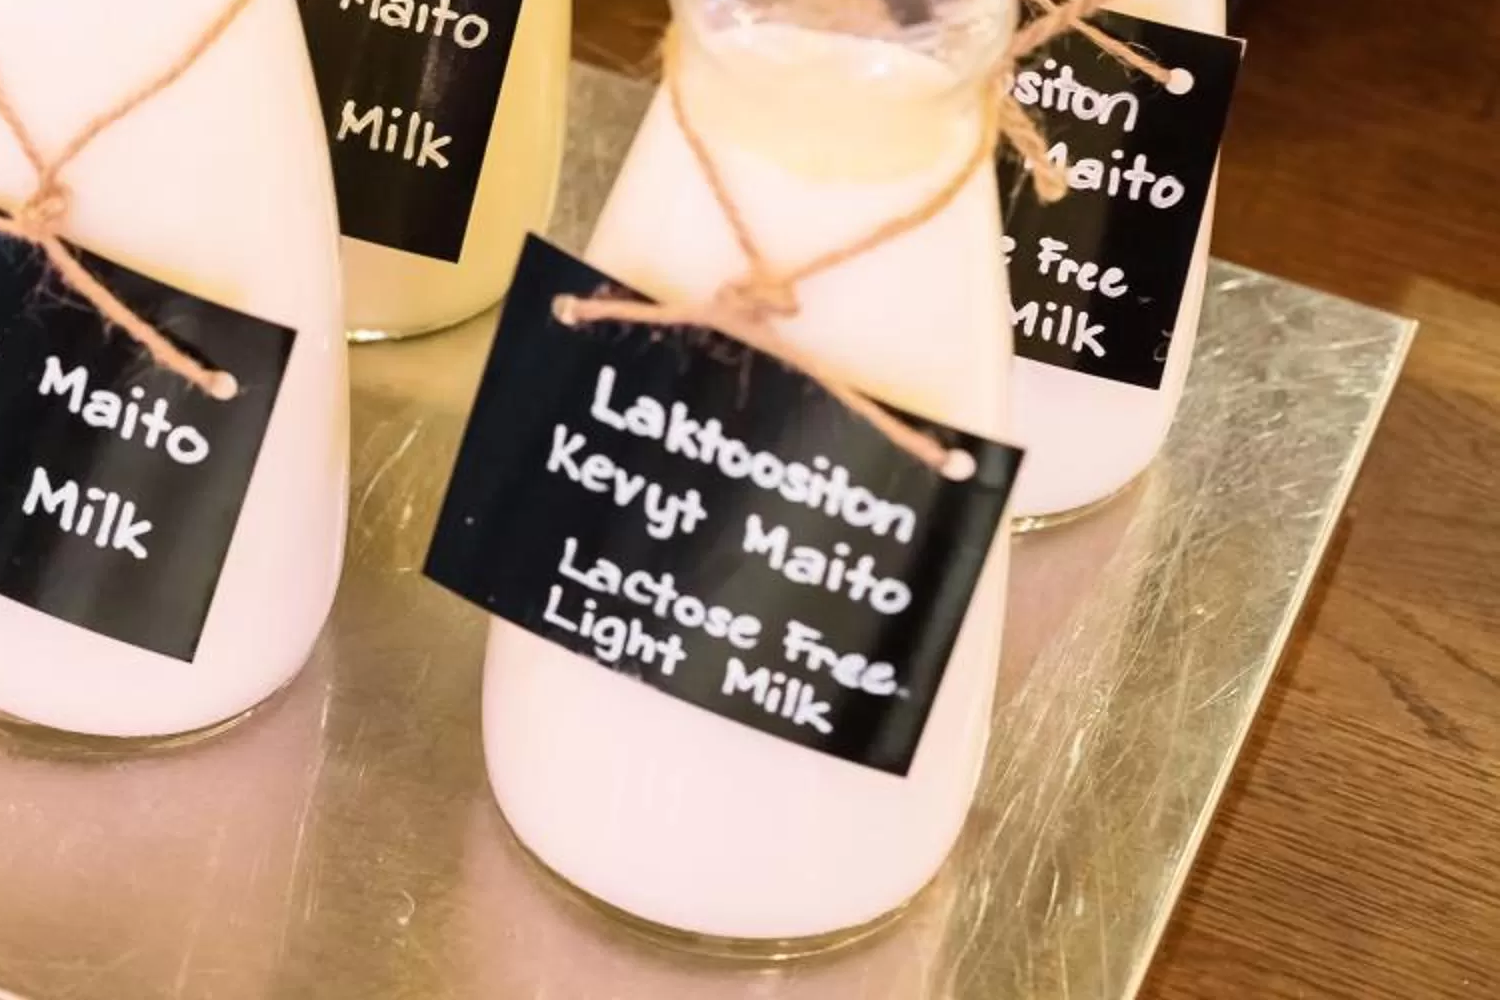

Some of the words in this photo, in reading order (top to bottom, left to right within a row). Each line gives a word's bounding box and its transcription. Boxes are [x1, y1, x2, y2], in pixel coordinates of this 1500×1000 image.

[335, 100, 453, 170] Milk
[1037, 236, 1130, 299] Free
[37, 355, 211, 465] Maito
[590, 366, 915, 544] Laktoositon
[21, 466, 154, 560] Milk
[545, 424, 708, 540] Kevyt
[743, 513, 913, 616] Maito
[558, 537, 763, 650] Lactose
[543, 585, 688, 676] Light
[721, 657, 834, 735] Milk
